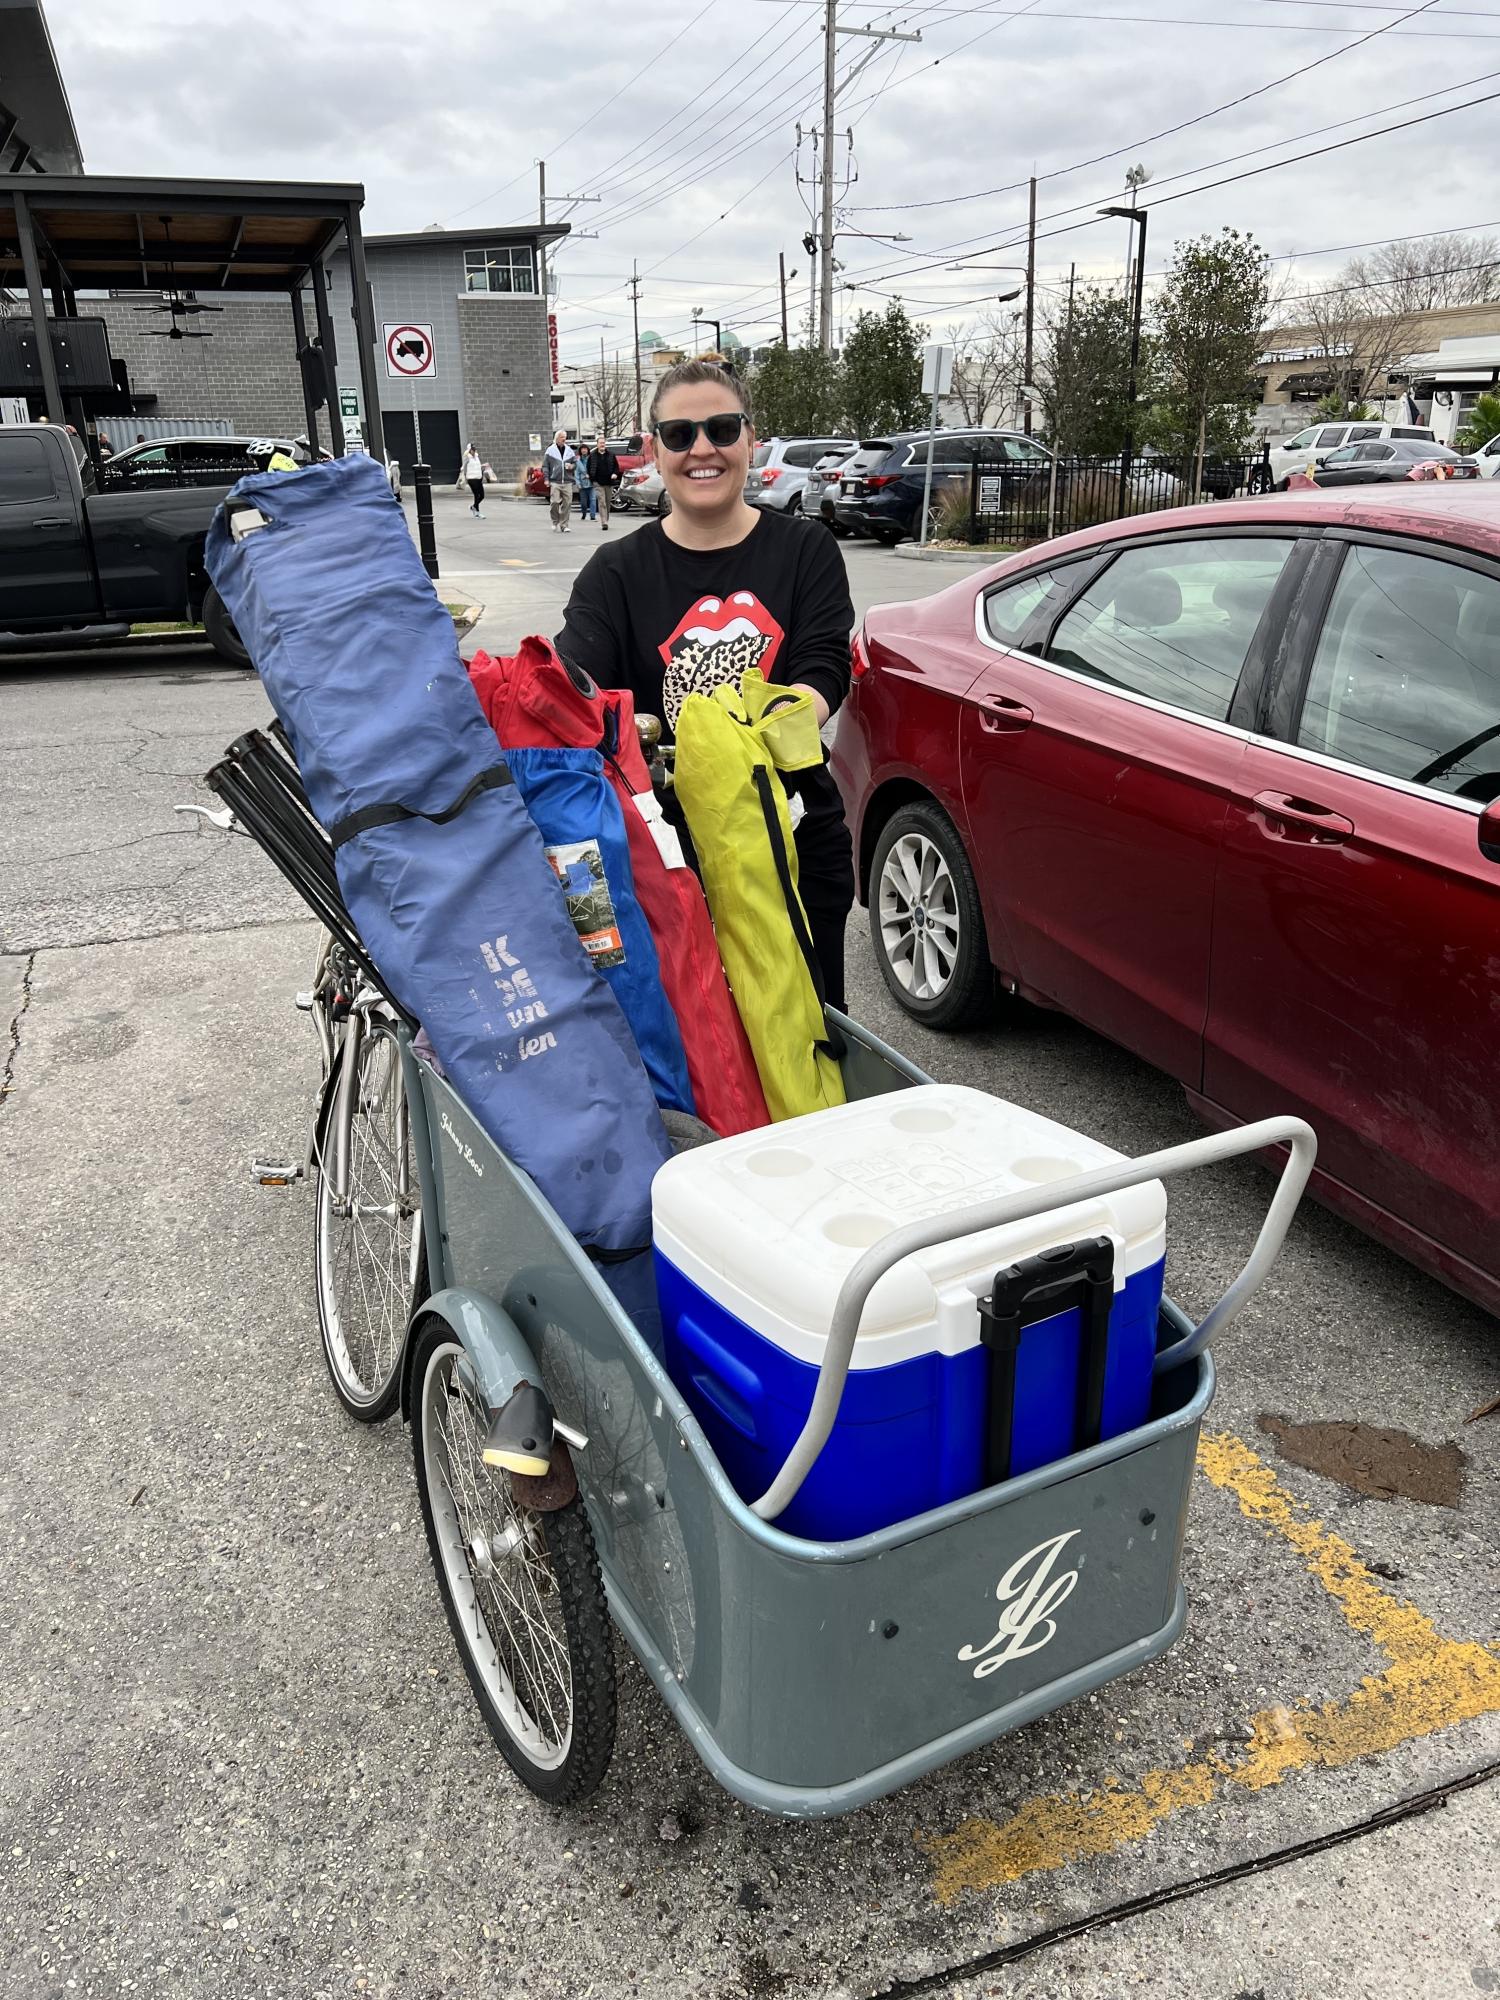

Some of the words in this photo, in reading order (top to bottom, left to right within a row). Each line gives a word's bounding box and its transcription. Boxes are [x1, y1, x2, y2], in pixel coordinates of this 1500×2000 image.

[547, 314, 559, 385] ROUSES
[440, 1112, 464, 1155] Johnny
[463, 1144, 483, 1177] Loco
